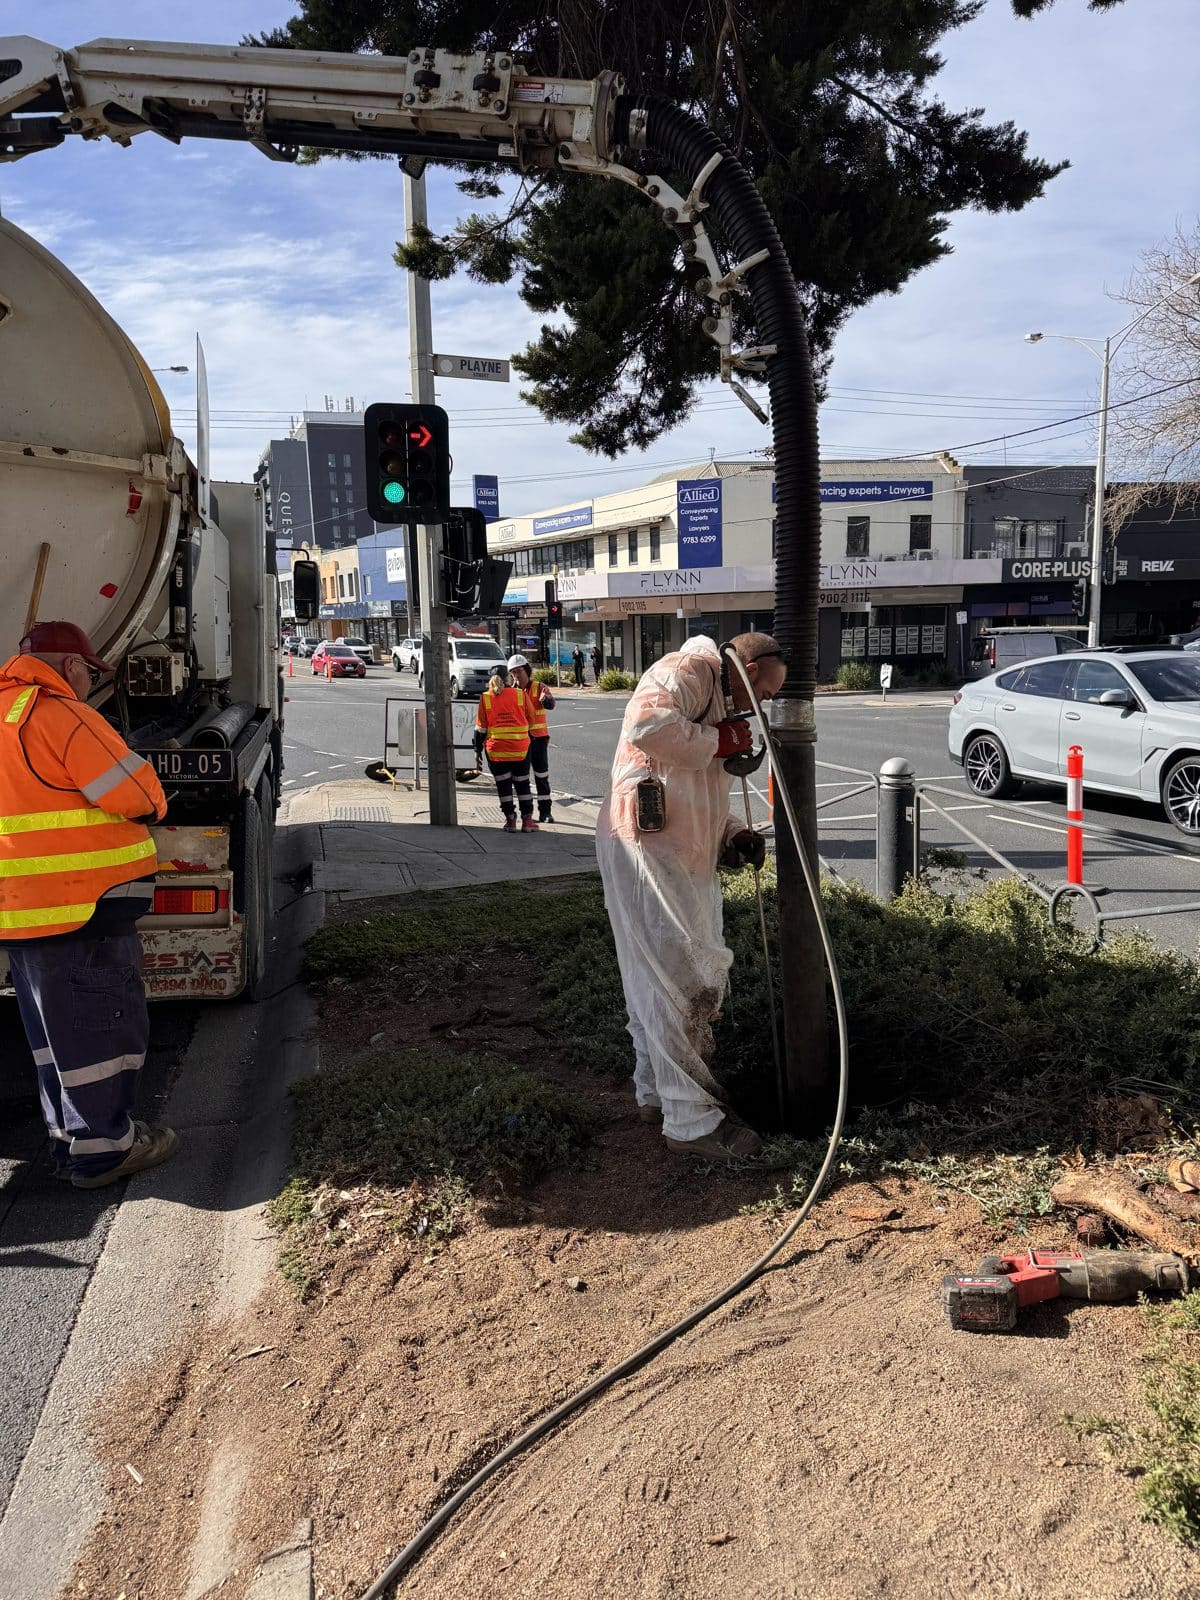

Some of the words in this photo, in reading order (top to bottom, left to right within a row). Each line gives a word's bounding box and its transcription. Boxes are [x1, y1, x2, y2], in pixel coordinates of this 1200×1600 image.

[460, 360, 502, 374] PLAYNE
[683, 490, 715, 502] Allied
[849, 485, 882, 497] experts
[889, 485, 925, 496] Lawyers
[680, 507, 719, 515] Conveyancing
[279, 491, 294, 545] QUEST
[682, 536, 699, 545] 9783
[699, 535, 717, 544] 6299
[640, 570, 702, 588] FLYNN
[820, 593, 848, 604] 9002
[621, 601, 636, 612] 9002
